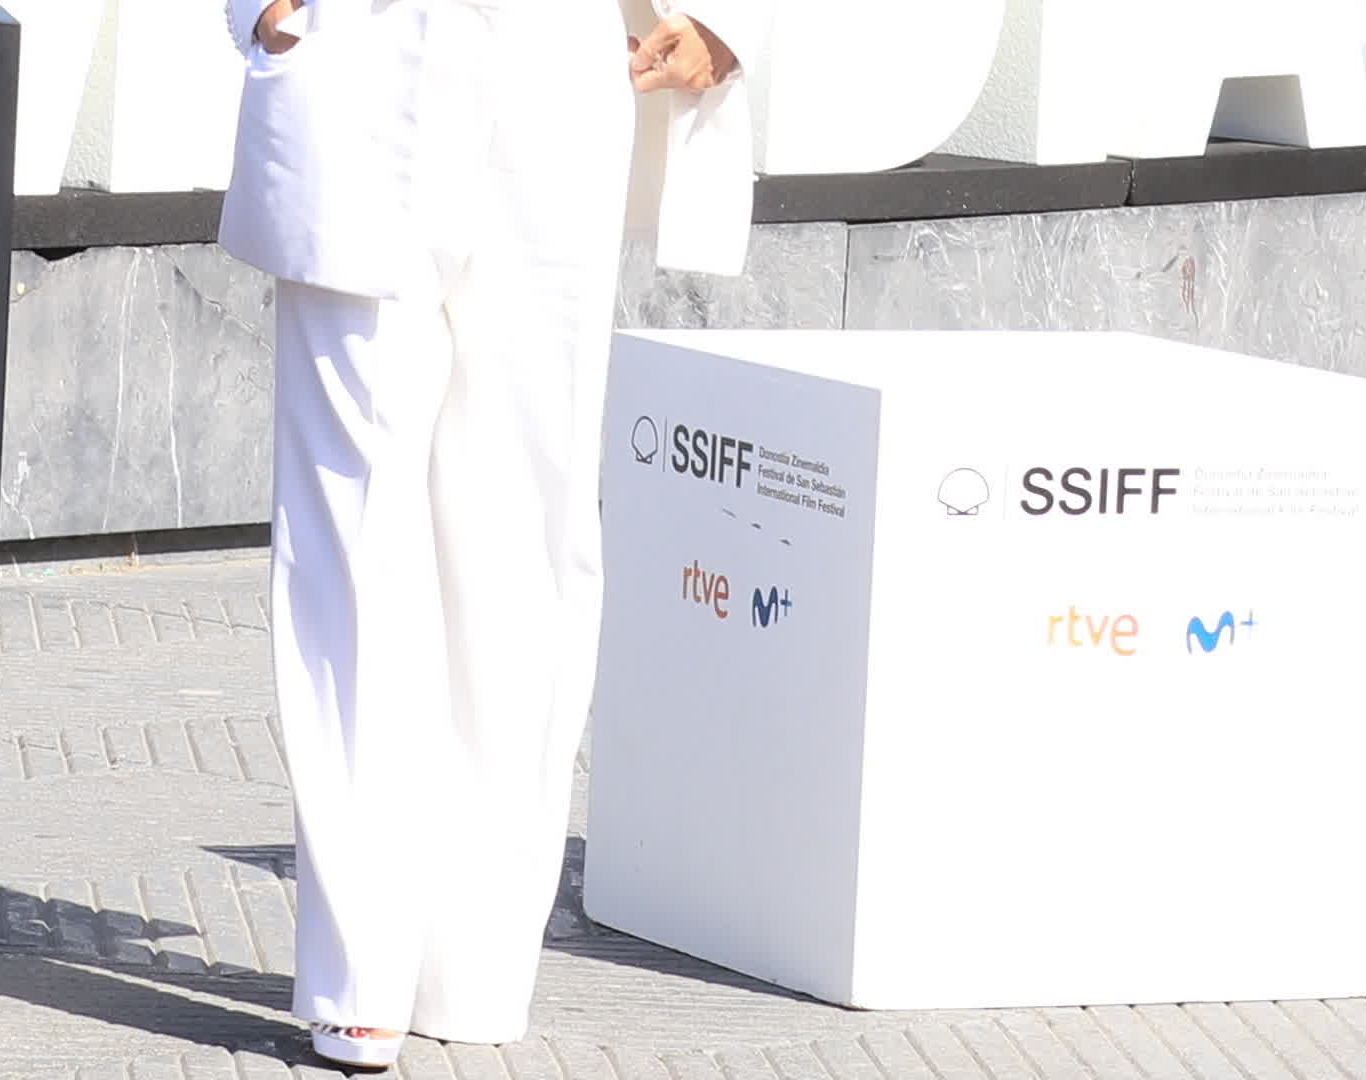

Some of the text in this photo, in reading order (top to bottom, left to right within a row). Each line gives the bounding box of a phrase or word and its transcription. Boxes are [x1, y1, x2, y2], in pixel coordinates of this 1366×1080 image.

[671, 424, 753, 488] SSIFF
[1020, 467, 1180, 515] SSIFF
[683, 559, 729, 619] rtve
[1046, 605, 1139, 656] rtve
